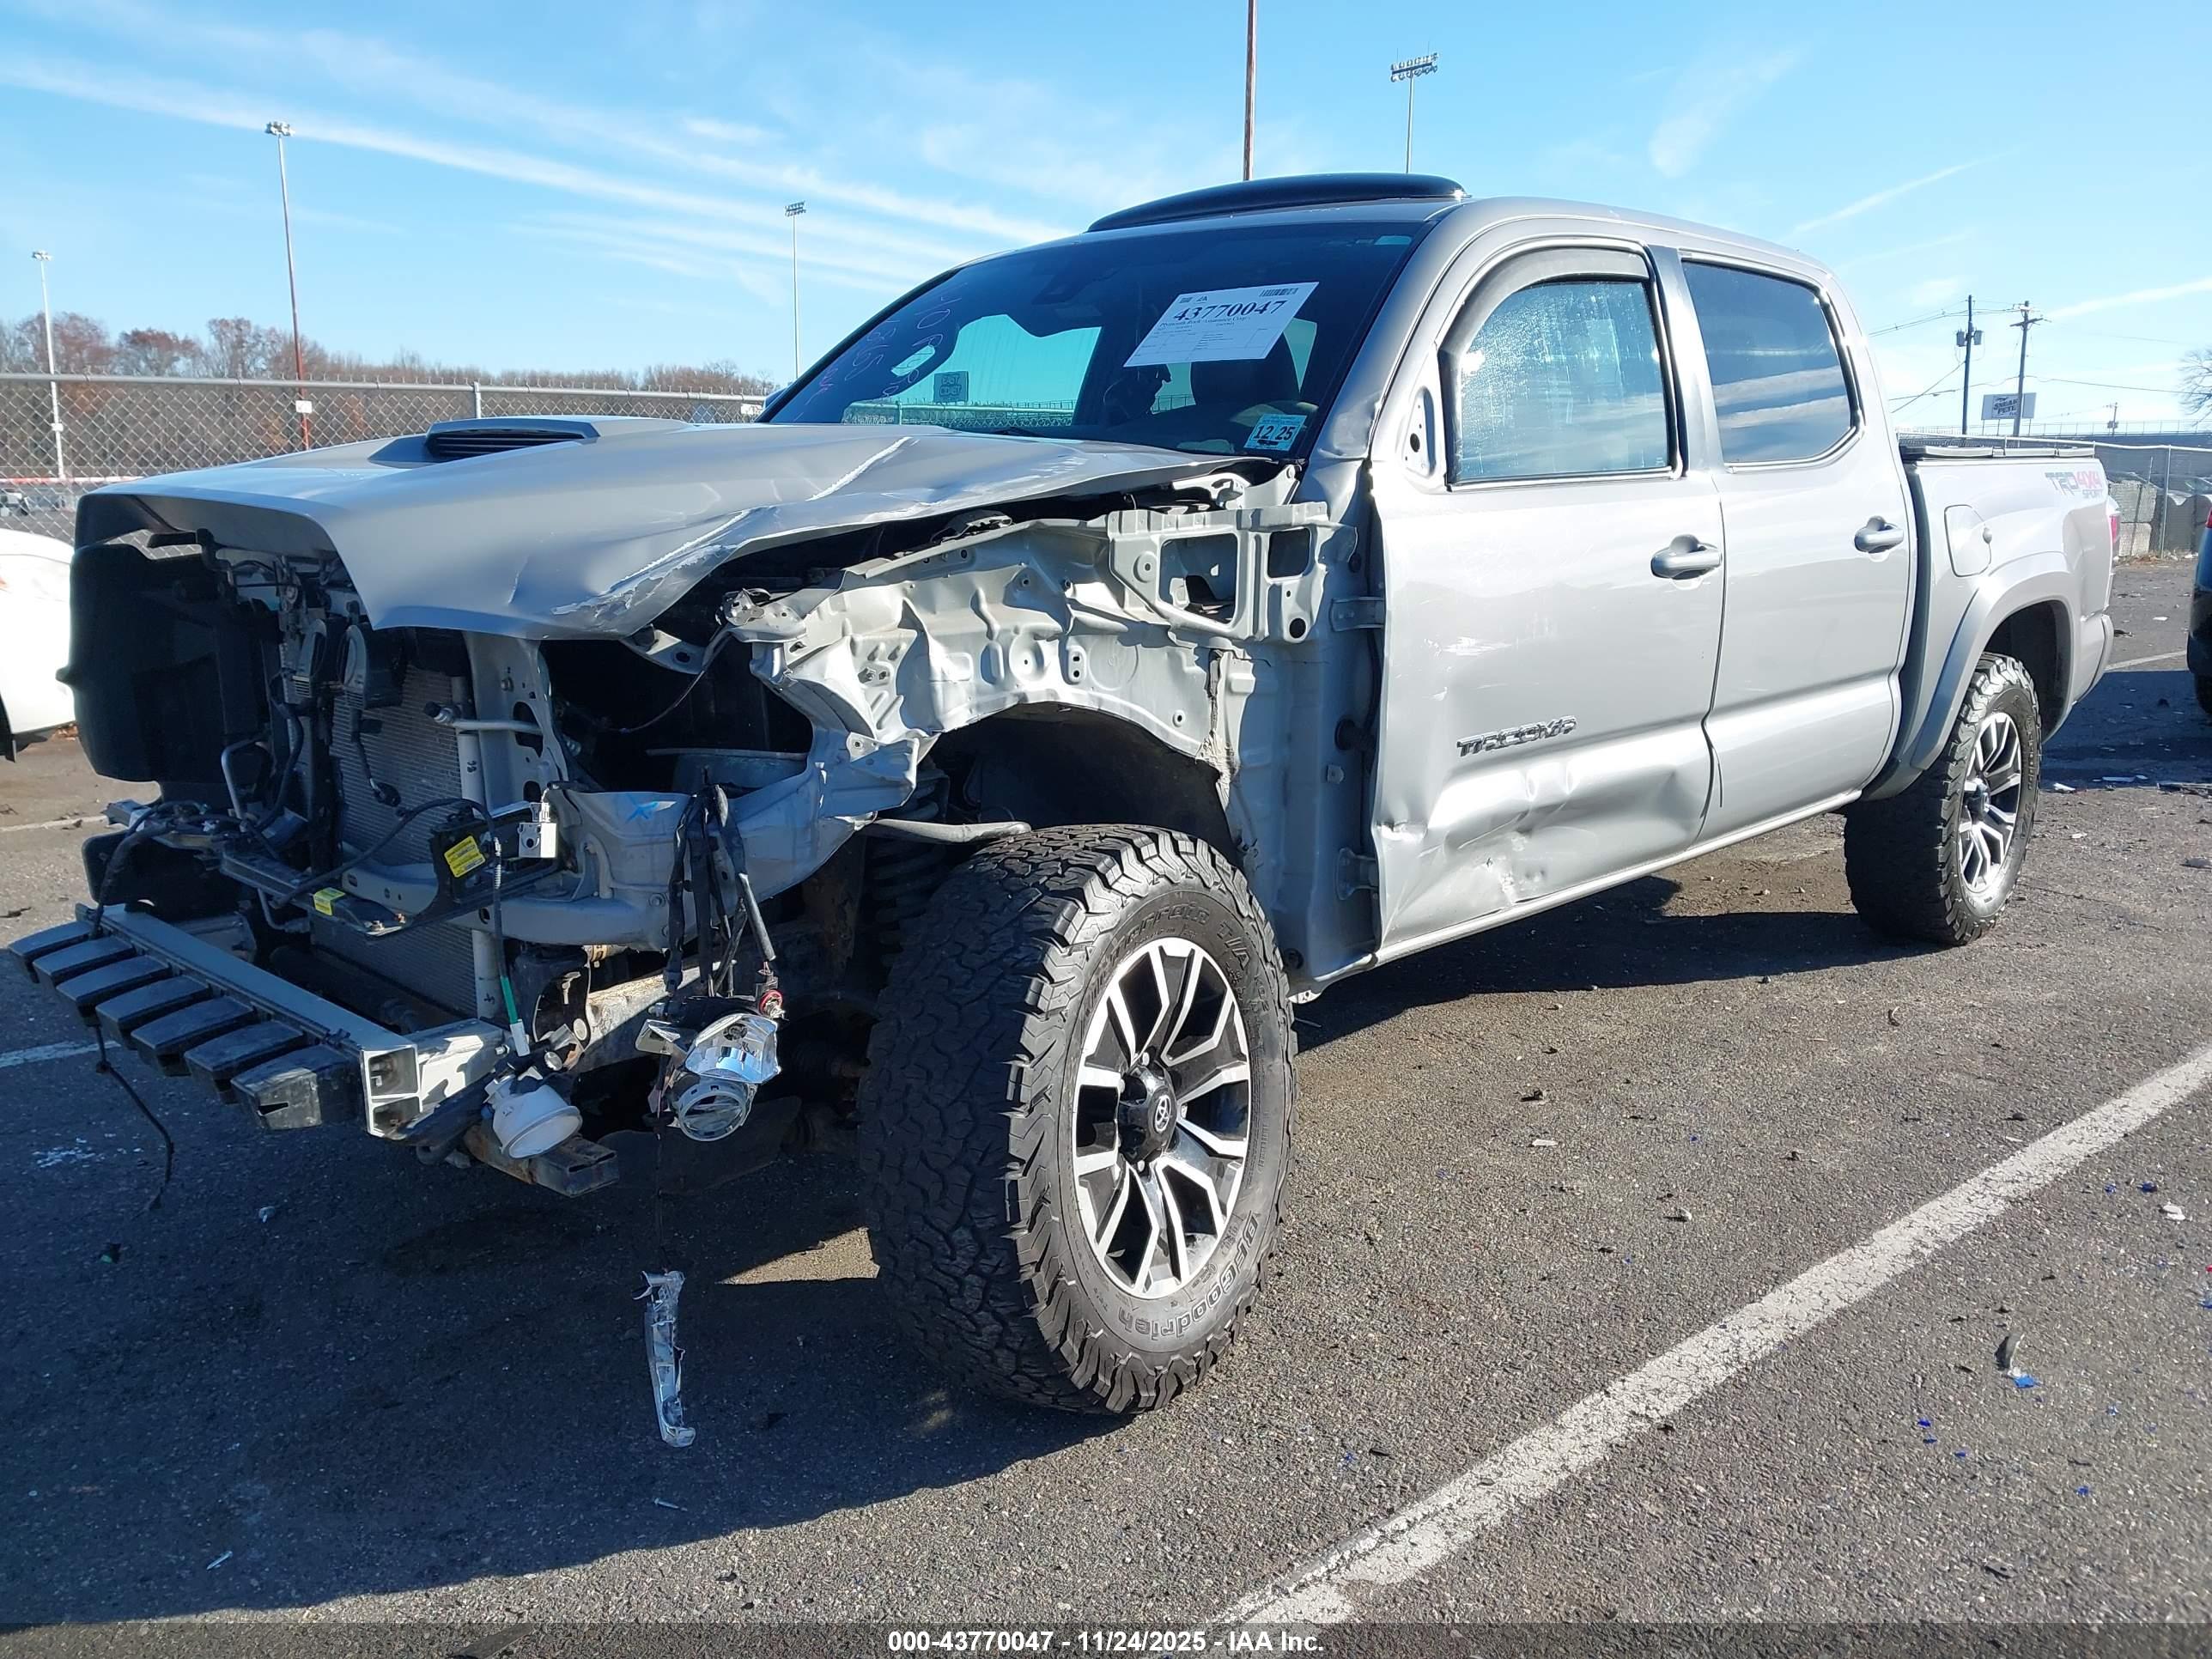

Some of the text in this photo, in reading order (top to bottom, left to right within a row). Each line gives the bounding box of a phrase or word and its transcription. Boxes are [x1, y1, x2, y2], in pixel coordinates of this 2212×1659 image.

[1174, 300, 1288, 320] 43770047
[1254, 425, 1296, 441] 12 25
[2045, 471, 2080, 495] TRD
[1456, 715, 1577, 757] TACOMA
[1118, 1215, 1260, 1340] BFGoodrich
